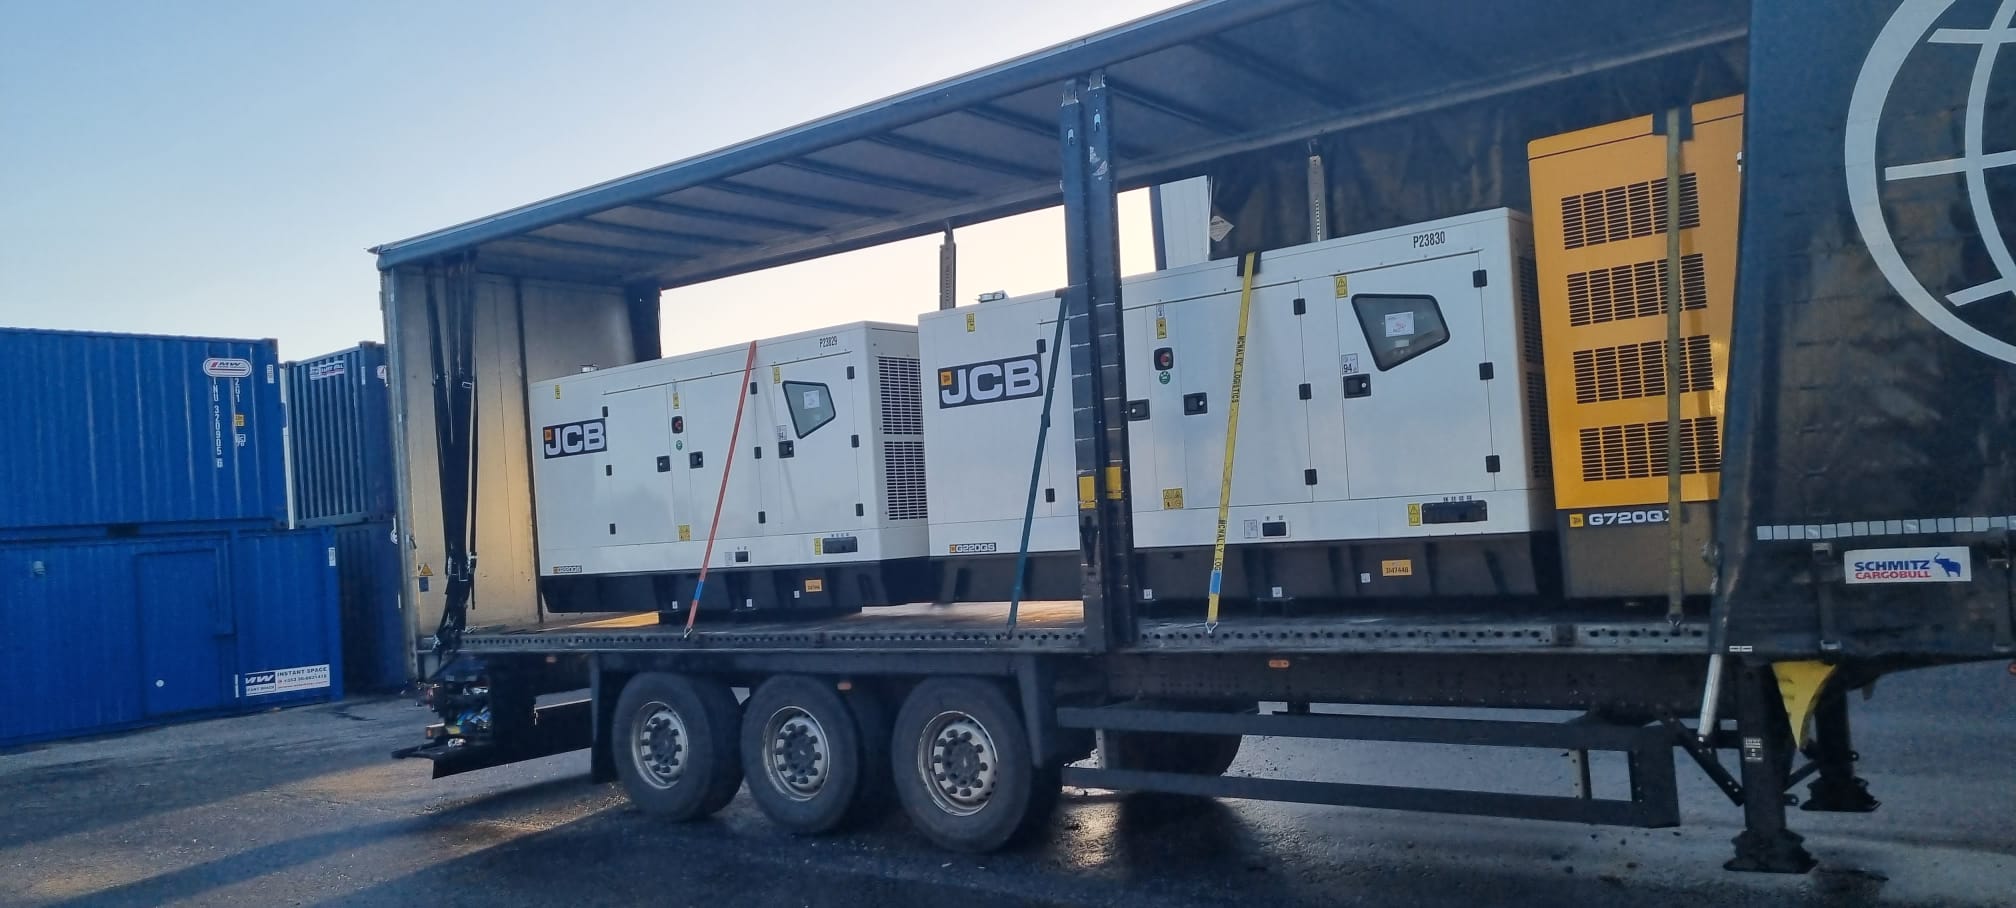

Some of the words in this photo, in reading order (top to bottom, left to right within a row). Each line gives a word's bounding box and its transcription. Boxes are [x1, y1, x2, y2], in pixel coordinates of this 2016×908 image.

[1413, 231, 1445, 248] P23830
[941, 359, 1040, 404] JCB
[545, 421, 605, 456] JCB
[1854, 560, 1930, 571] SCHMITZ
[1855, 570, 1932, 579] CARGOBULL
[277, 669, 305, 677] INSTANT
